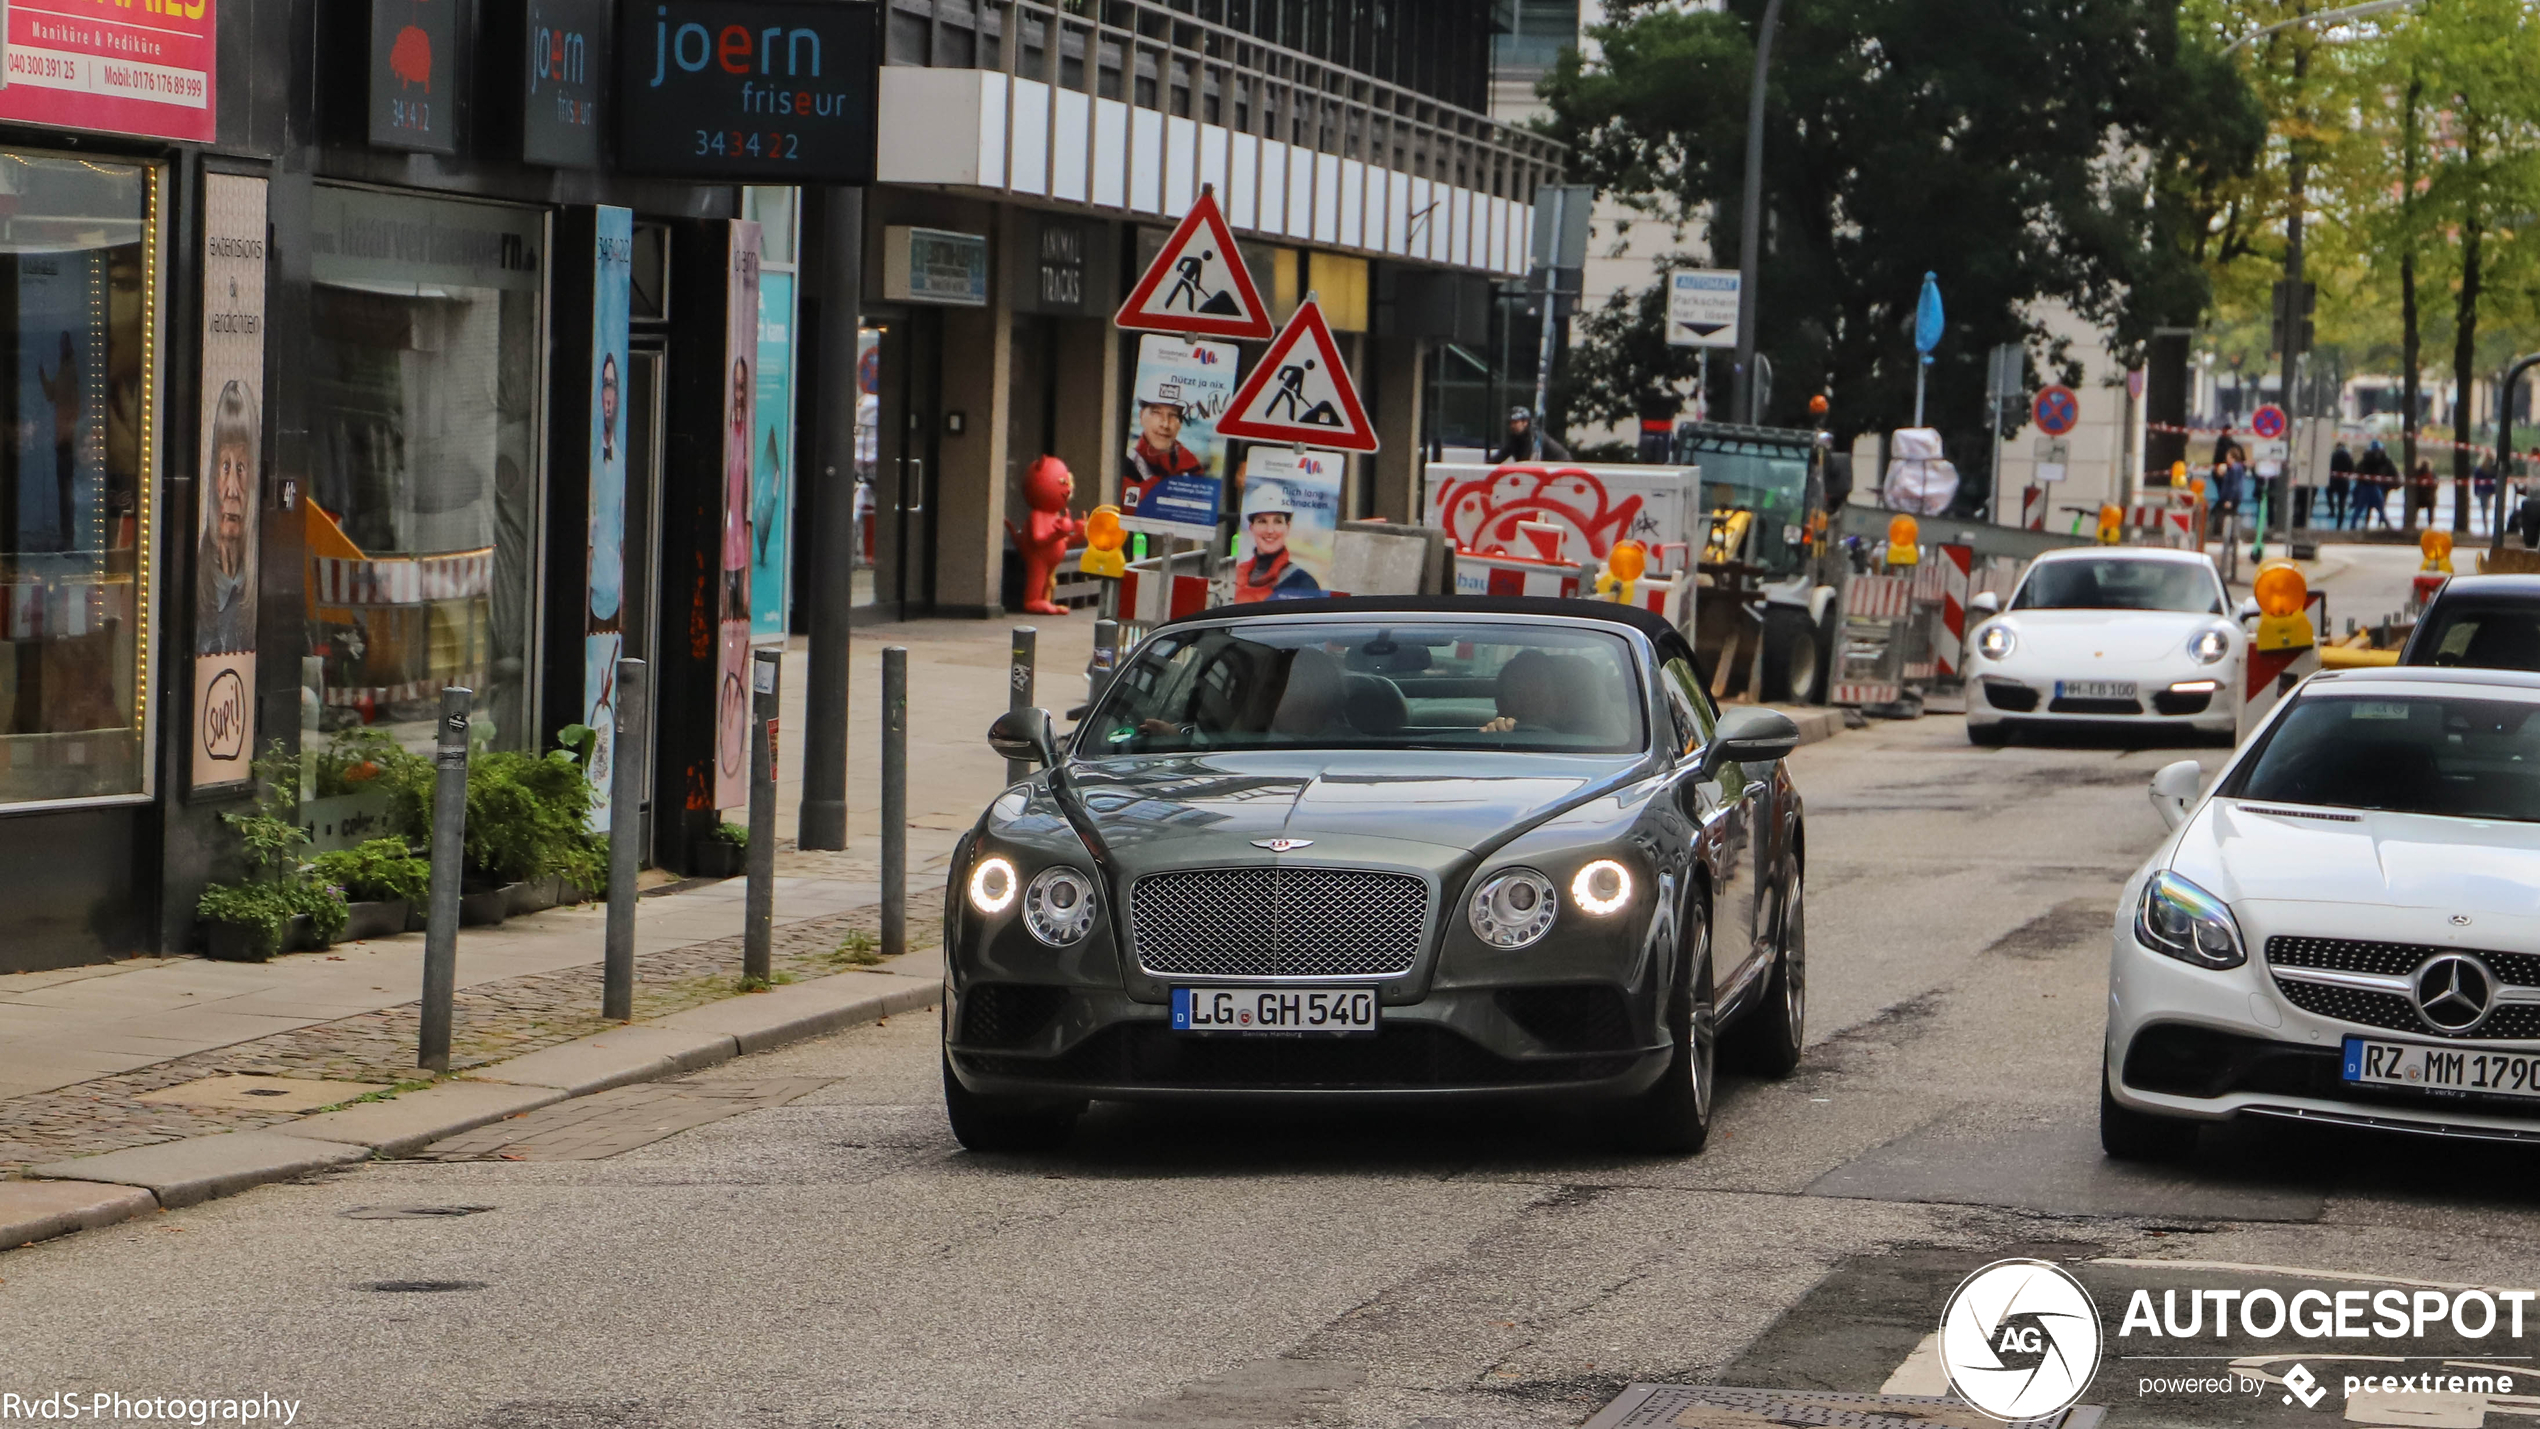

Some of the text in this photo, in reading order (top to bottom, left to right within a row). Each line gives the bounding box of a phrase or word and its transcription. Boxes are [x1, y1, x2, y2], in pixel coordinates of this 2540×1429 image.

[32, 21, 161, 56] Maniküre & Pediküre
[531, 8, 584, 95] joern
[650, 5, 820, 87] joern
[8, 53, 202, 97] 040 300 391 25 Mobil: 0176 176 89 999
[742, 81, 846, 116] friseur
[209, 235, 263, 260] extensions
[1679, 277, 1731, 290] AUTOMAT
[208, 312, 260, 334] verdichten
[1673, 309, 1693, 318] hier
[1176, 992, 1370, 1025] D LG GH 540
[2348, 1063, 2356, 1073] D
[2365, 1045, 2404, 1079] RZ
[2424, 1051, 2464, 1085] MM
